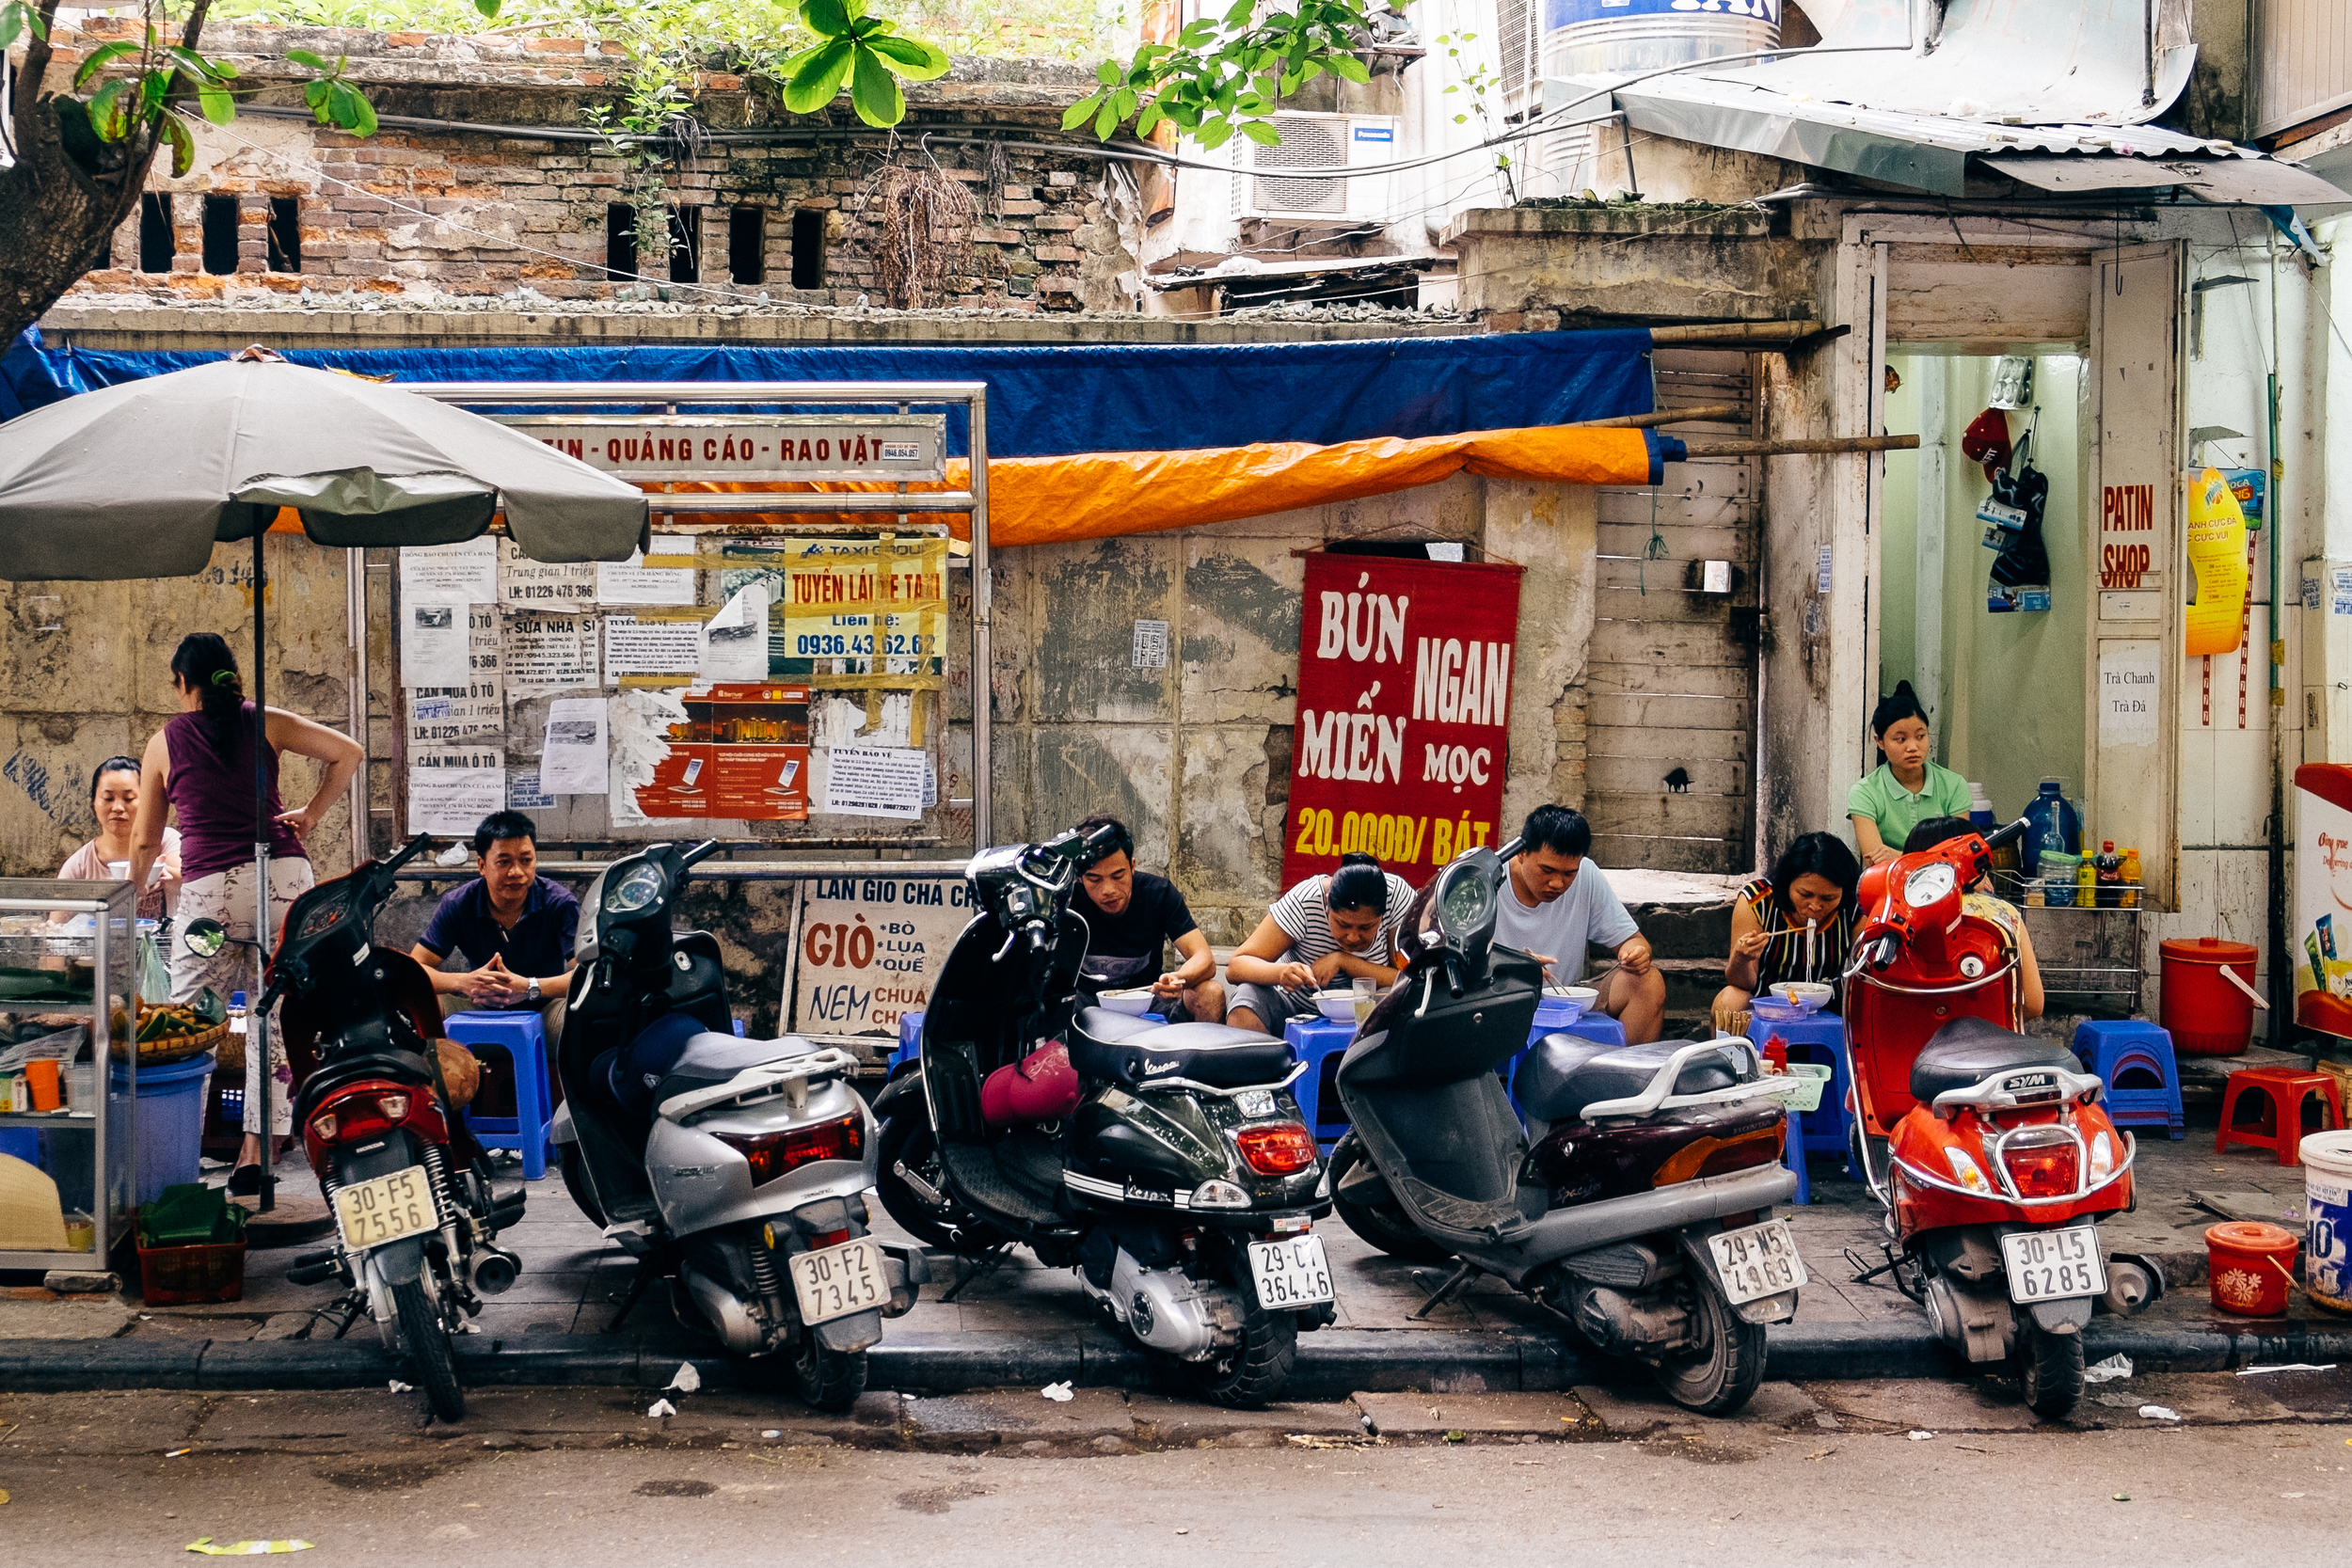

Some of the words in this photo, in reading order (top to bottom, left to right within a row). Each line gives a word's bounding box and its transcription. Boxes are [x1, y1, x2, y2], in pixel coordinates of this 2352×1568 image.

[607, 432, 692, 463] QUẢNG
[703, 434, 754, 461] CÁO
[781, 438, 830, 461] RAO
[838, 434, 882, 466] VẶT
[2103, 483, 2154, 532] PATIN
[506, 565, 538, 579] Trung
[538, 567, 561, 579] gian
[791, 561, 844, 605] TUYỂN
[849, 567, 874, 604] LÁI
[2100, 543, 2151, 589] SHOP
[509, 585, 523, 599] LH:
[526, 585, 553, 598] 01226
[576, 584, 593, 597] 366
[479, 612, 492, 628] TÔ
[547, 617, 574, 633] NHÀ
[832, 613, 867, 626] Liên
[1317, 571, 1409, 664] BÚN
[481, 655, 498, 668] 366
[2104, 672, 2122, 685] Trà
[2123, 671, 2155, 685] Chanh
[481, 681, 494, 698] TÔ
[1412, 637, 1510, 727] NGAN
[2112, 700, 2129, 712] Trà
[2132, 700, 2146, 712] Đá
[432, 725, 459, 739] 01226
[1298, 680, 1407, 784] MIẾN
[444, 755, 469, 768] MUA
[483, 752, 496, 768] TÔ
[1422, 743, 1491, 794] MỌC
[1432, 809, 1491, 865] BÁT
[805, 912, 875, 970] GIÒ
[808, 984, 871, 1022] NEM
[874, 988, 927, 1006] CHUA
[1144, 1057, 1180, 1075] Vespa
[2009, 1073, 2047, 1088] SYM
[348, 1174, 415, 1214] 30-F5
[355, 1202, 422, 1243] 7556
[804, 1244, 869, 1286] 30-F2
[2017, 1231, 2086, 1266] 30-L5
[811, 1274, 876, 1317] 7345
[2023, 1262, 2092, 1297] 6285
